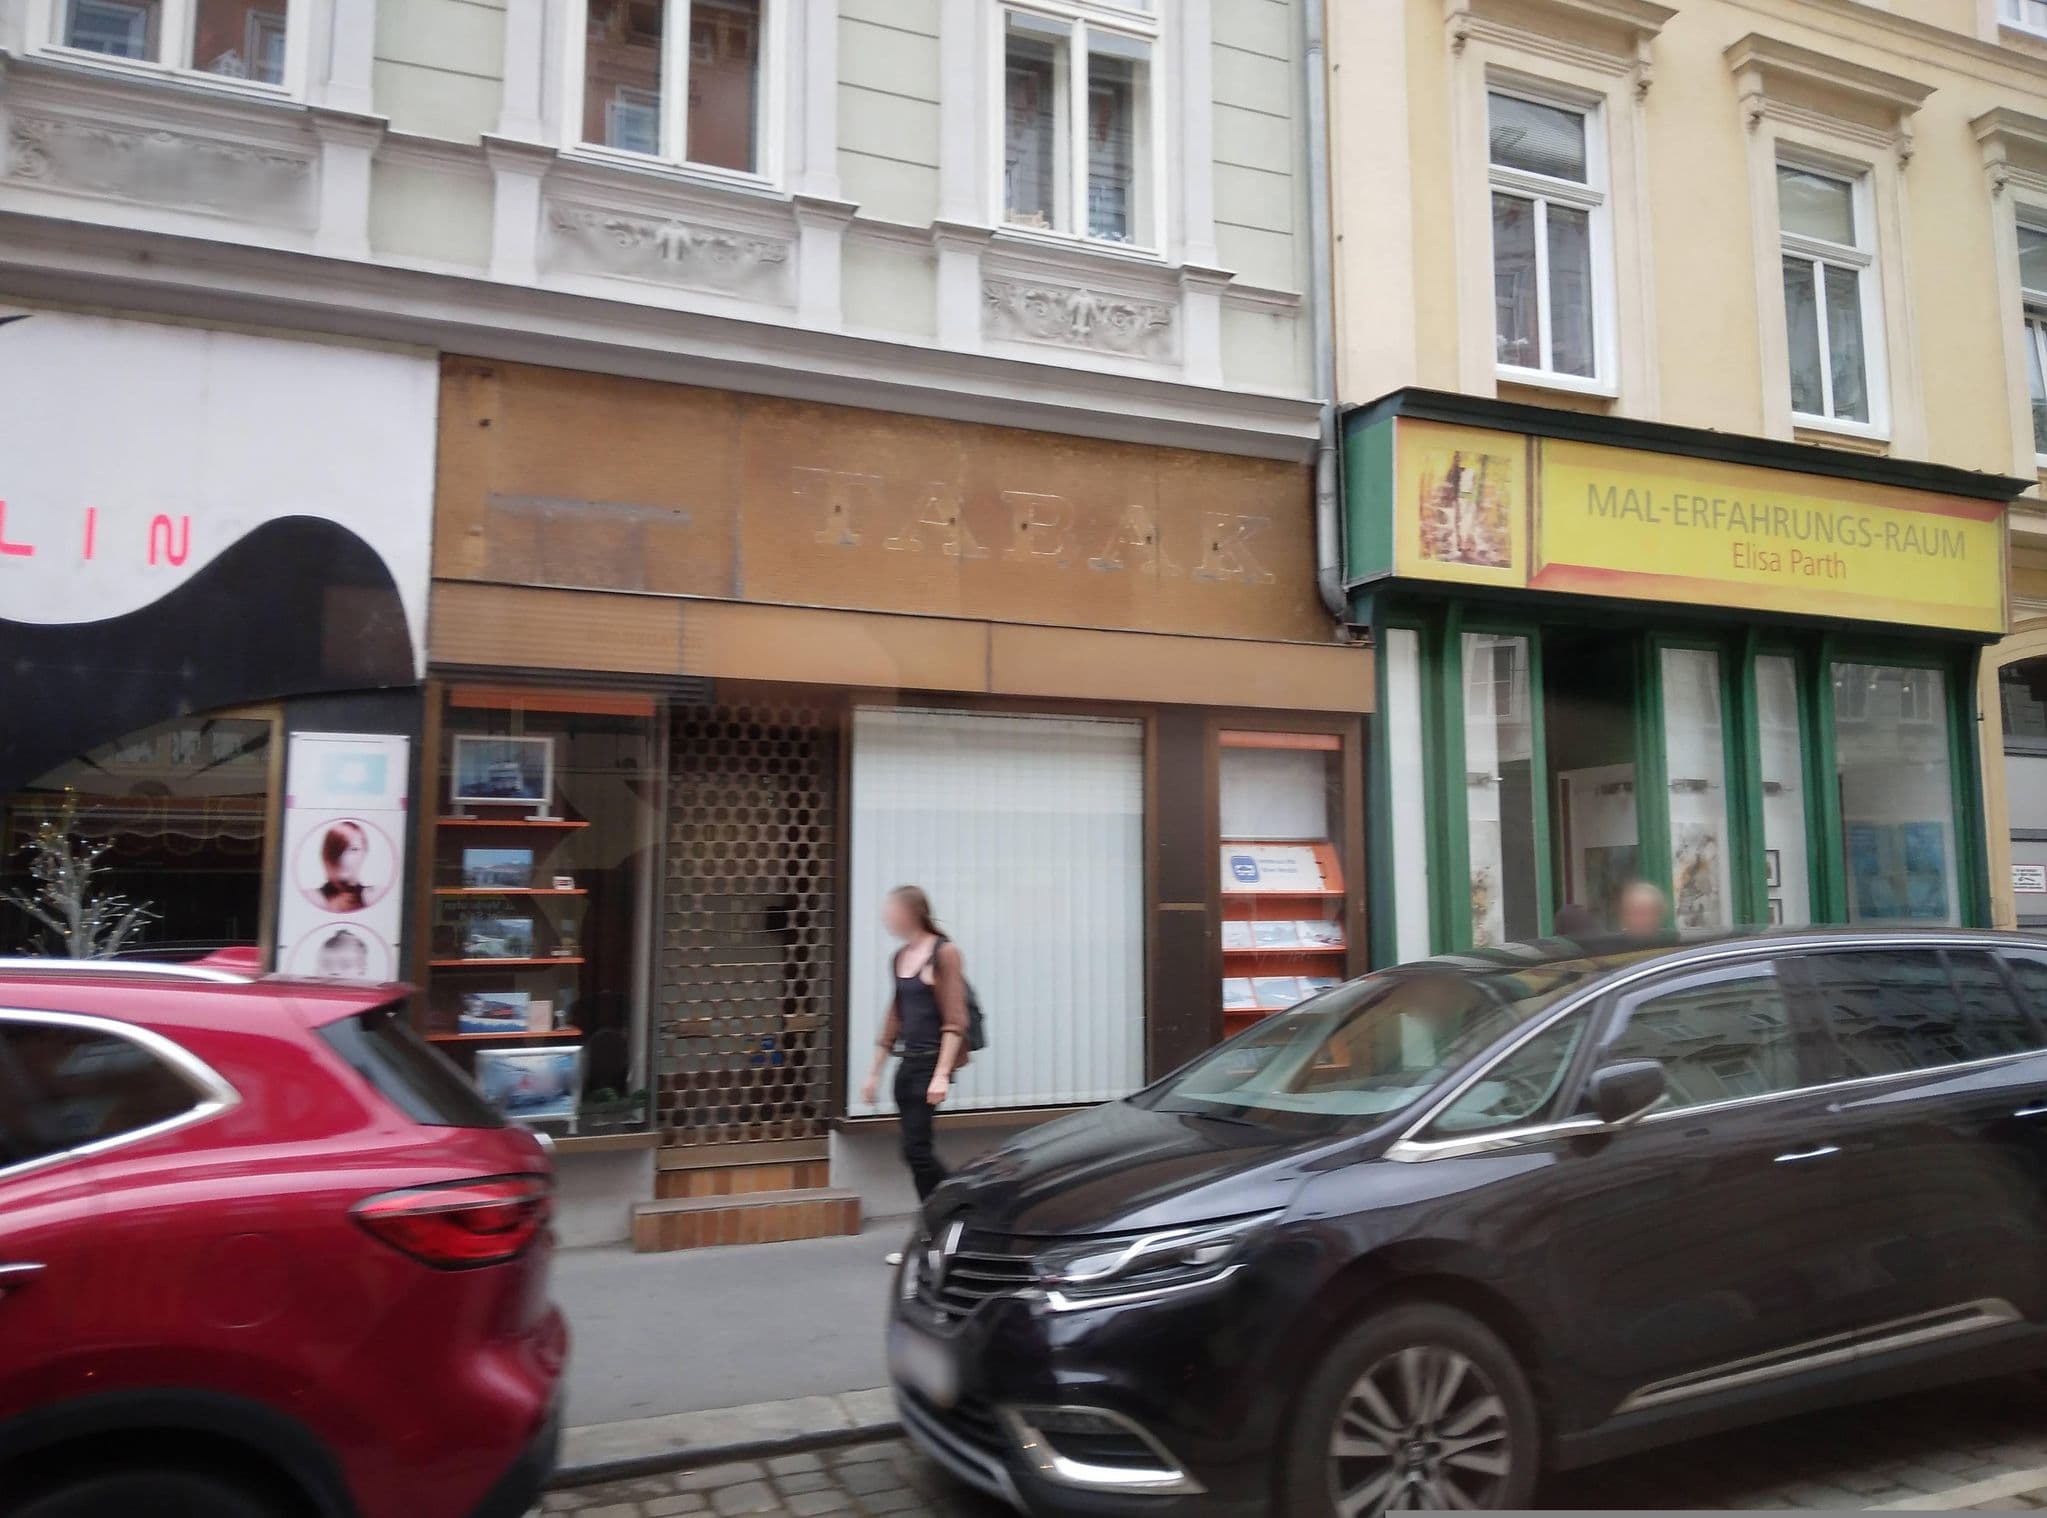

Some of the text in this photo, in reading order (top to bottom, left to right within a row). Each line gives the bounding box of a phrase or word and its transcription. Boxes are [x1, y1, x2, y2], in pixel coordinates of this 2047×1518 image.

[792, 465, 1275, 584] TABAK
[1587, 482, 1966, 561] MAL-ERFAHRUNGS-RAUM
[1732, 541, 1847, 580] Elisa Parth
